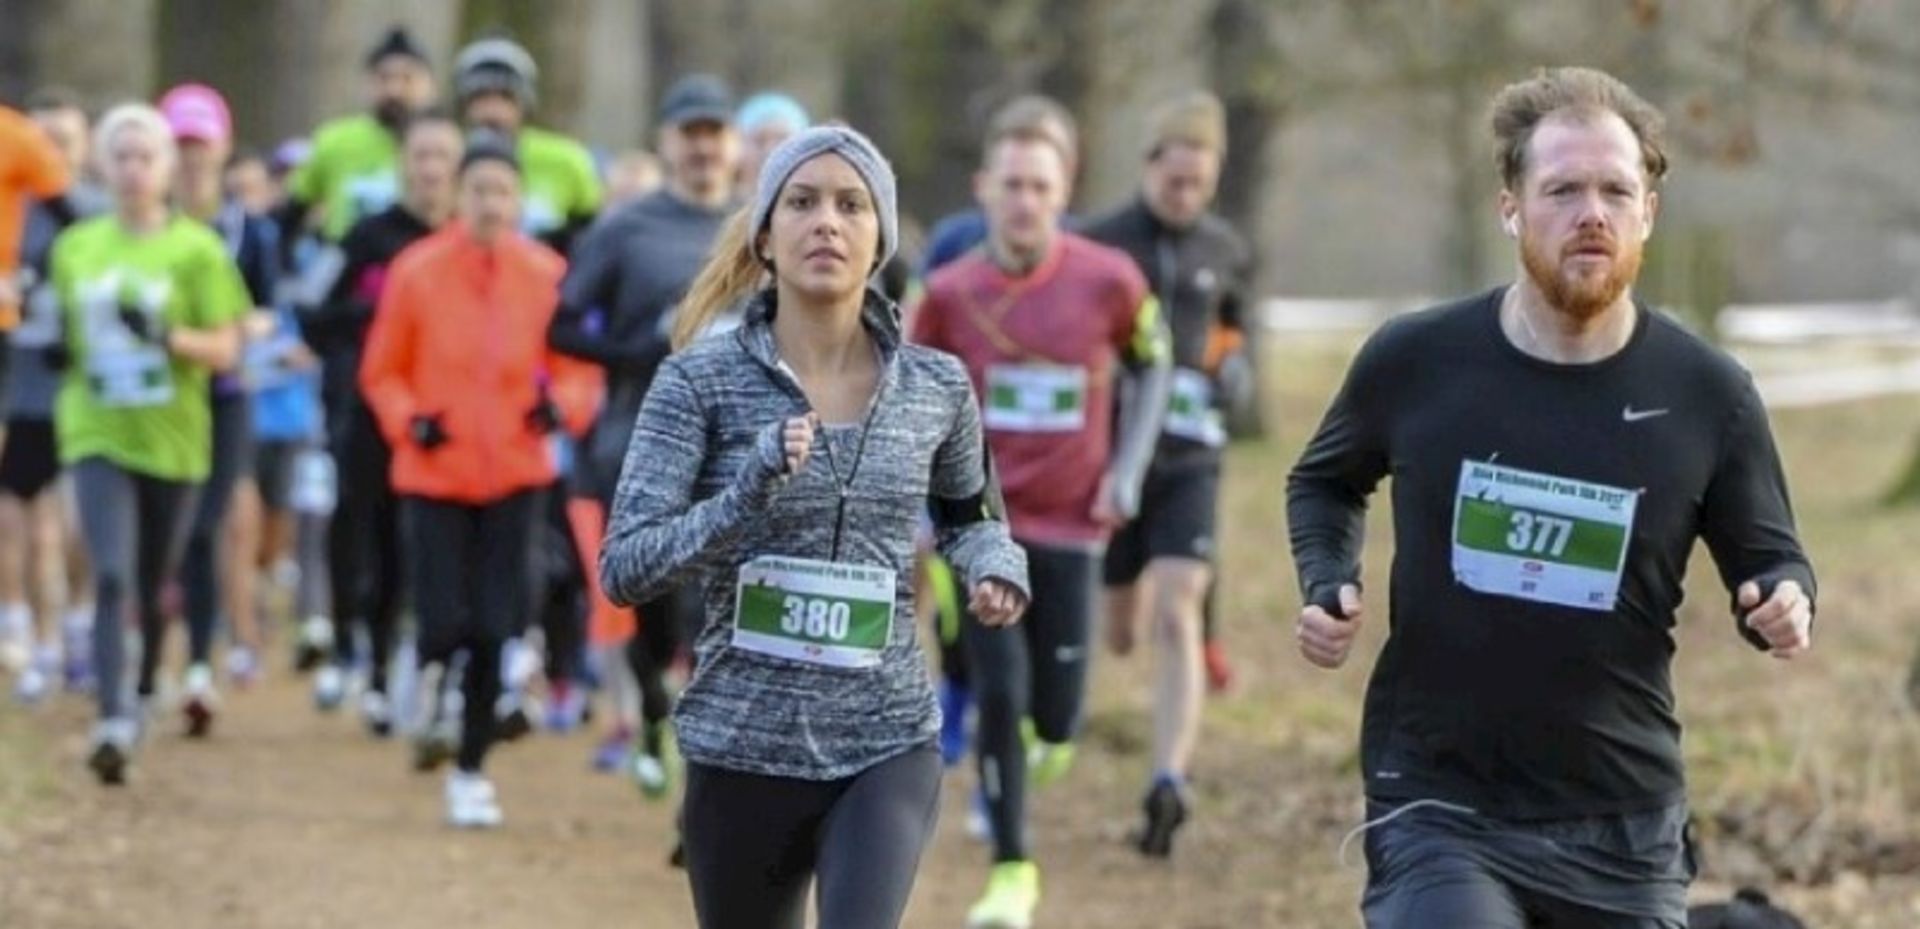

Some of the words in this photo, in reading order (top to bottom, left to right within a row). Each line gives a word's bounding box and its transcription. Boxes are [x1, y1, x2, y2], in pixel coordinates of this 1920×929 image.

[1552, 482, 1576, 496] Park
[1506, 510, 1574, 556] 377
[781, 595, 851, 641] 380
